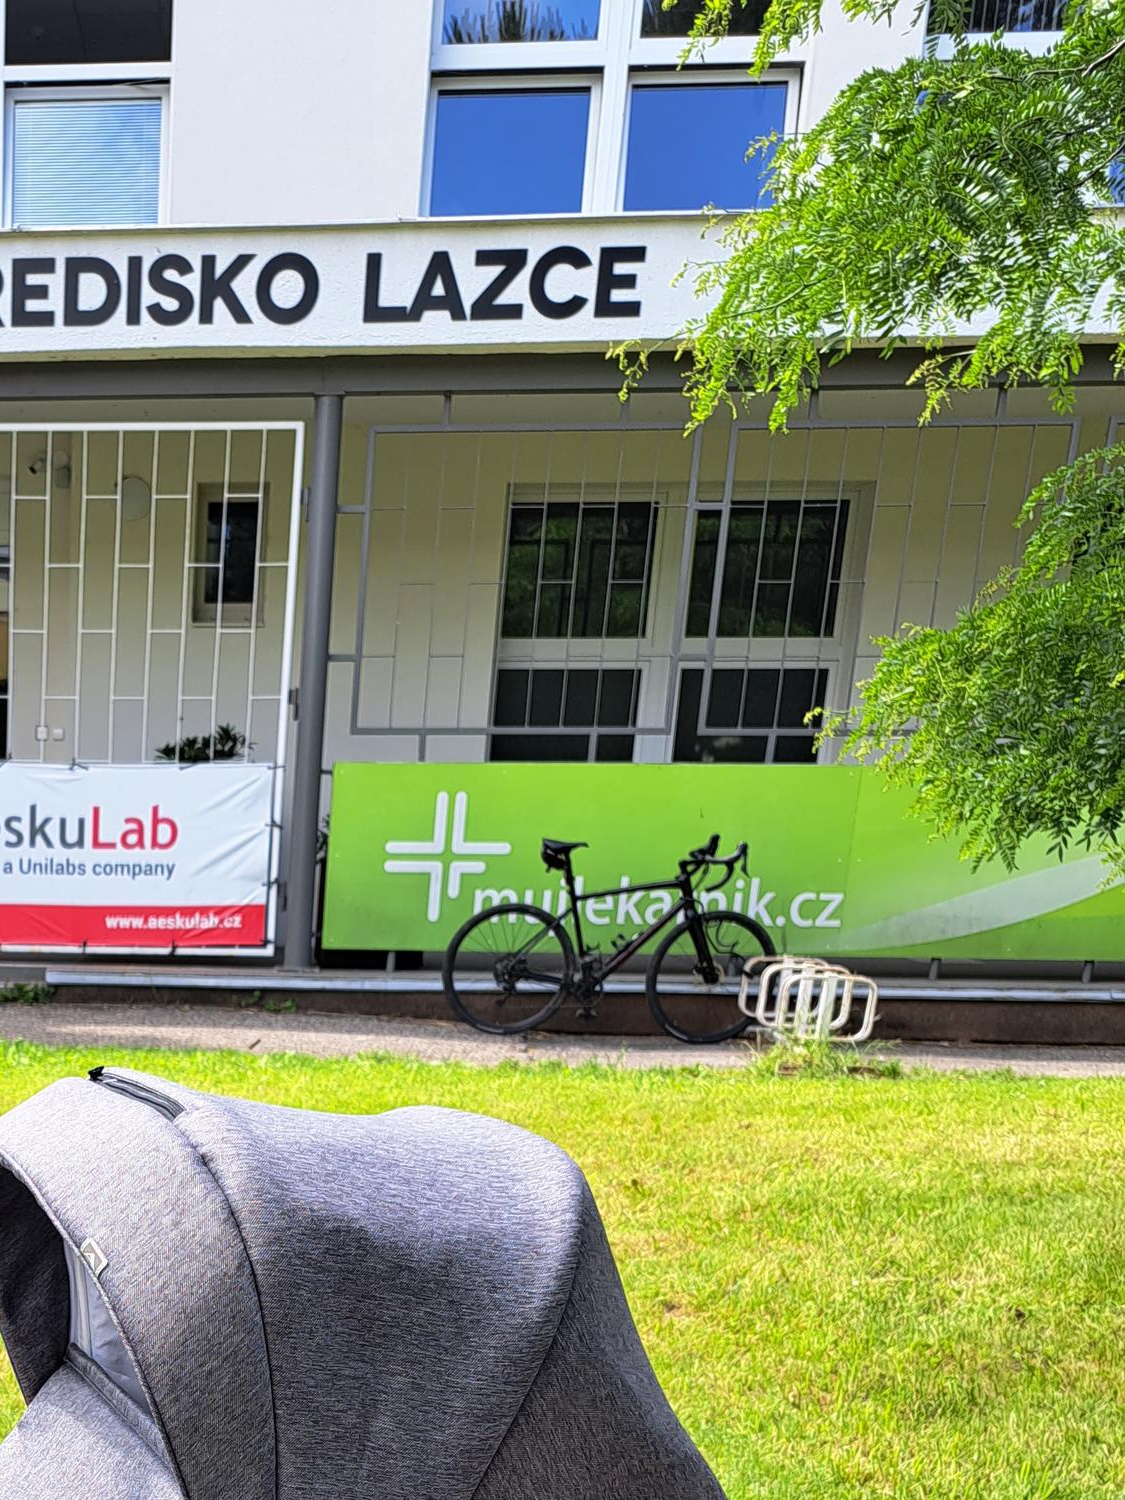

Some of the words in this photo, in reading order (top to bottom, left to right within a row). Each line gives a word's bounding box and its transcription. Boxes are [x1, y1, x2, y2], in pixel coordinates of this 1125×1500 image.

[362, 245, 647, 324] LAZCE
[2, 860, 14, 875] a
[18, 857, 87, 876] Unilabs
[92, 861, 176, 881] company
[104, 911, 243, 930] www.aeskulab.cz
